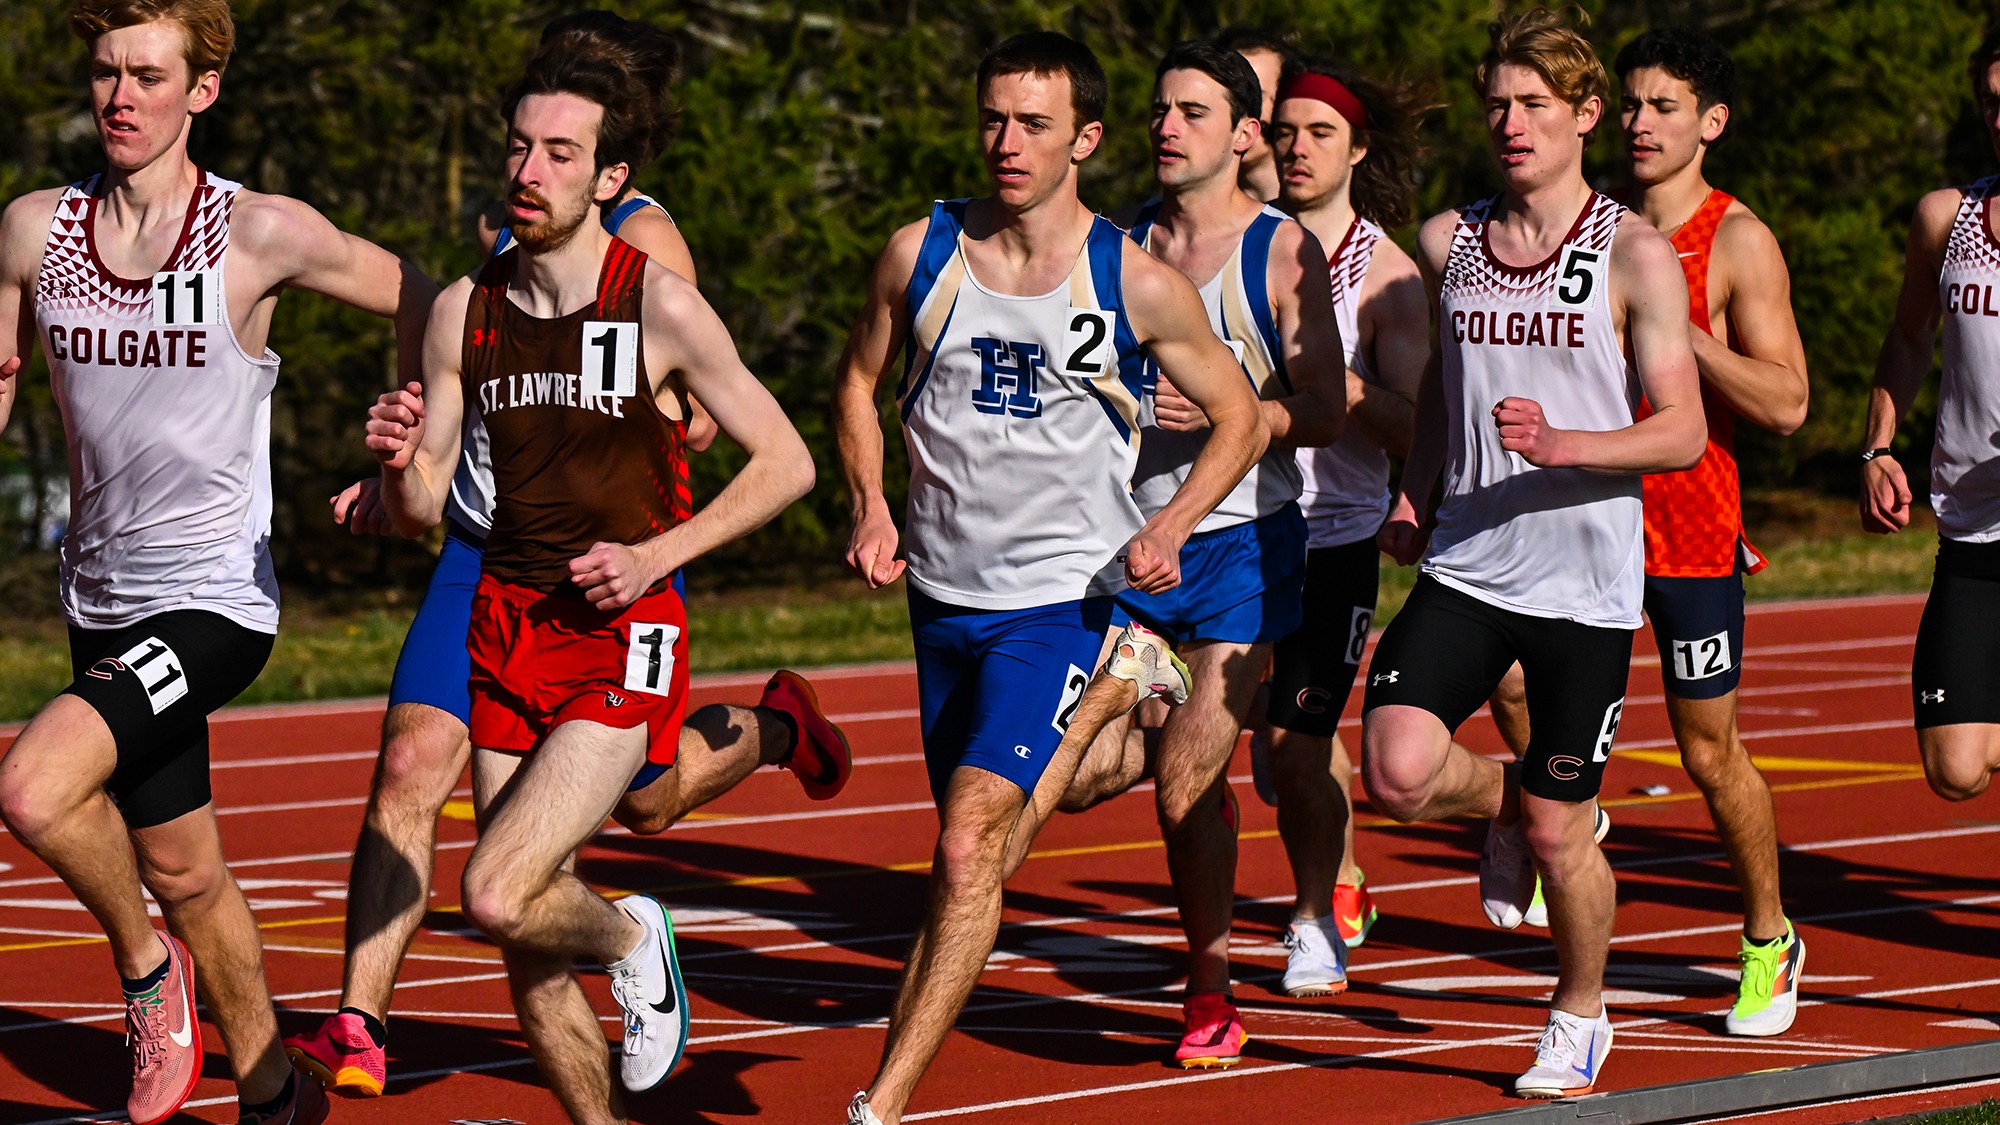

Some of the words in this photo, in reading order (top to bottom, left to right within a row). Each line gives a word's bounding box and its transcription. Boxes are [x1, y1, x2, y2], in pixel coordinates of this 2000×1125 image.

[157, 273, 204, 324] 11
[1558, 250, 1599, 305] 5
[50, 325, 207, 368] COLGATE
[1066, 313, 1106, 373] 2
[1452, 310, 1585, 348] COLGATE
[591, 328, 618, 391] 1
[971, 337, 1046, 419] H
[479, 377, 504, 416] ST.
[639, 628, 663, 689] 1
[1350, 611, 1371, 661] 8
[1677, 637, 1724, 678] 12
[130, 642, 182, 697] 11
[1056, 673, 1087, 733] 2
[1600, 702, 1623, 757] 5
[1547, 755, 1584, 780] C
